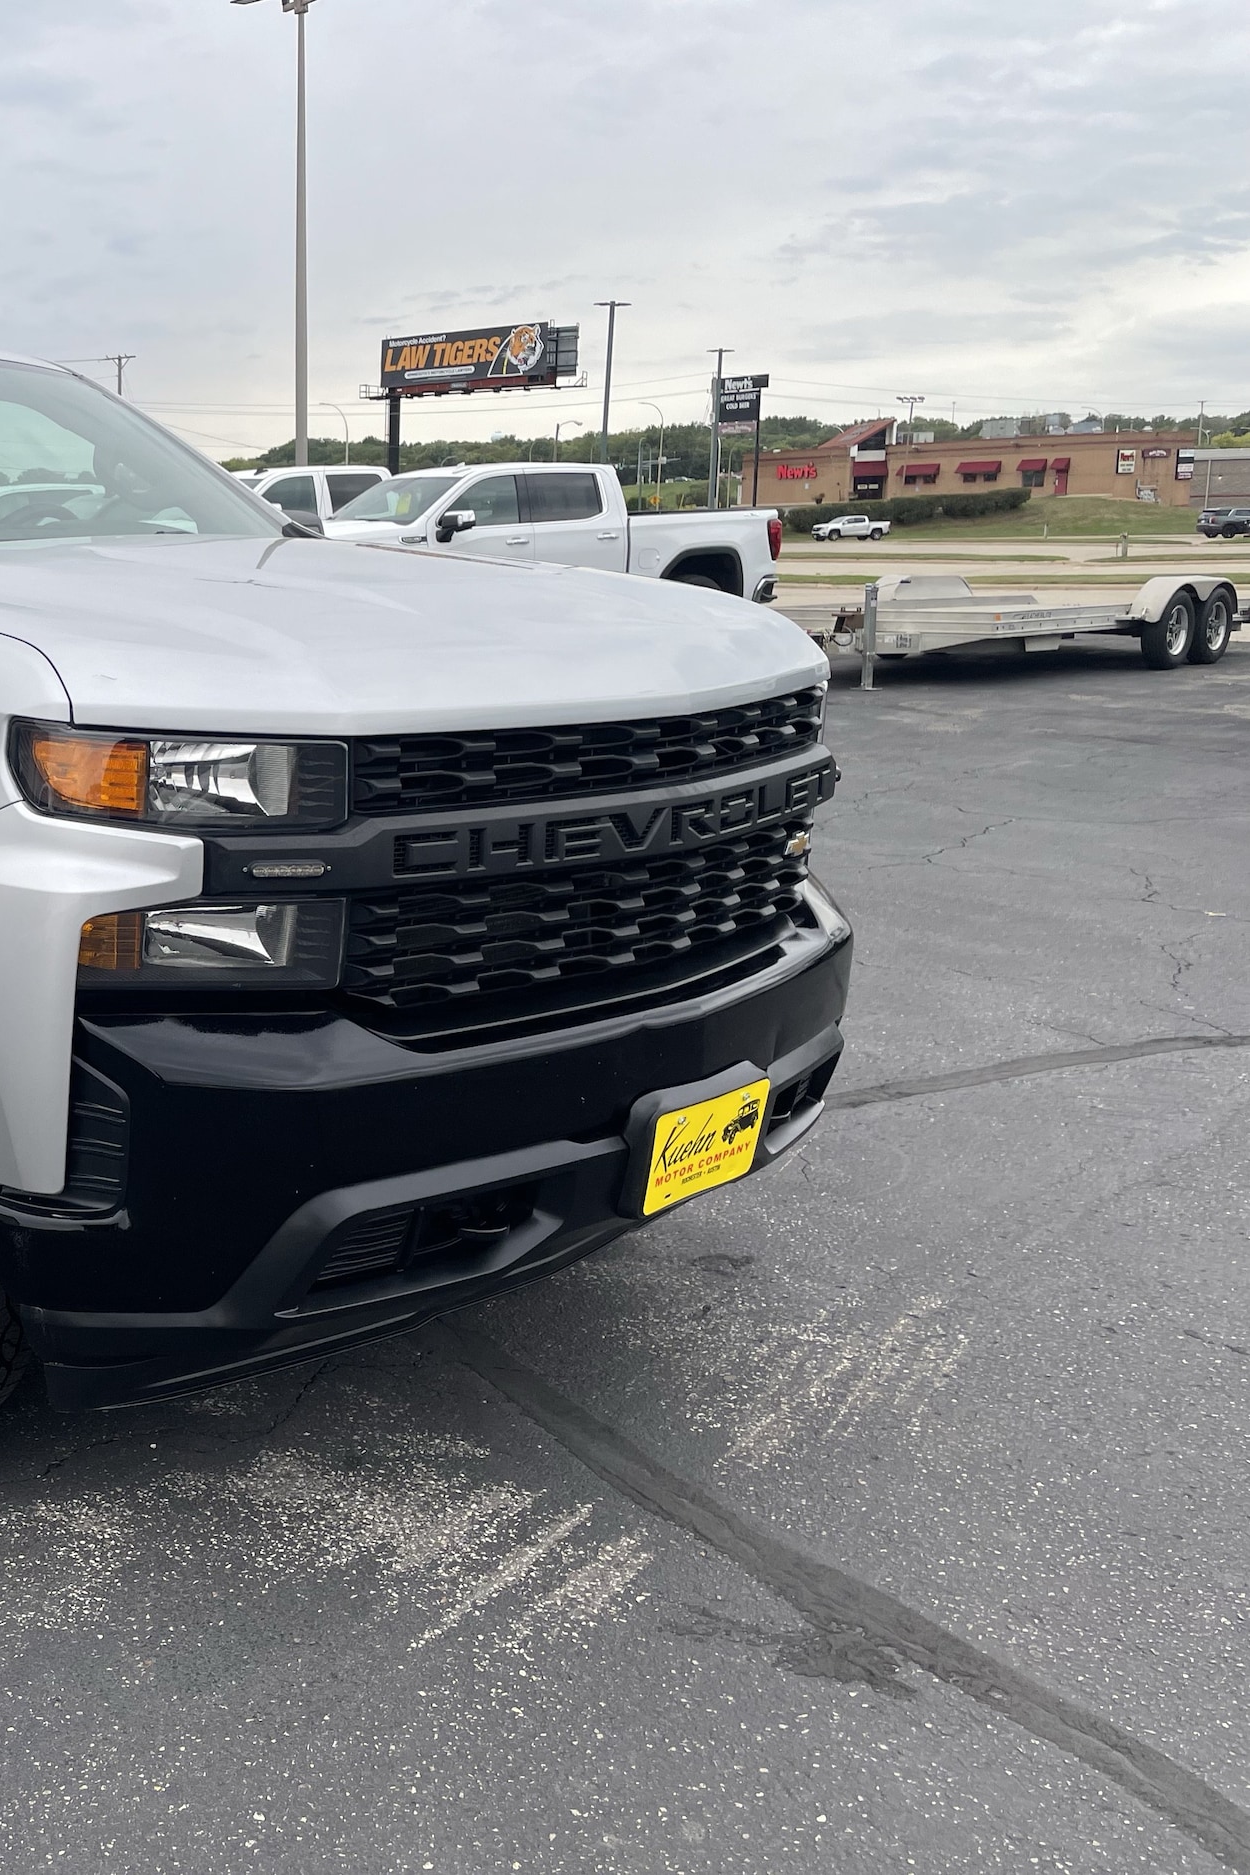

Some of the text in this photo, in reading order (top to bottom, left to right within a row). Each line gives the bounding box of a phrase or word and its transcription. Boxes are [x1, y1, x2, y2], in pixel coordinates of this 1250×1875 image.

[384, 336, 501, 372] LAW TIGERS
[389, 334, 447, 347] Motorcycle Accident?
[724, 376, 753, 391] Newt's
[776, 462, 817, 480] Newt's
[392, 764, 832, 879] CHEVROLET
[654, 1113, 717, 1173] Kuehn
[655, 1141, 752, 1188] MOTOR COMPANY
